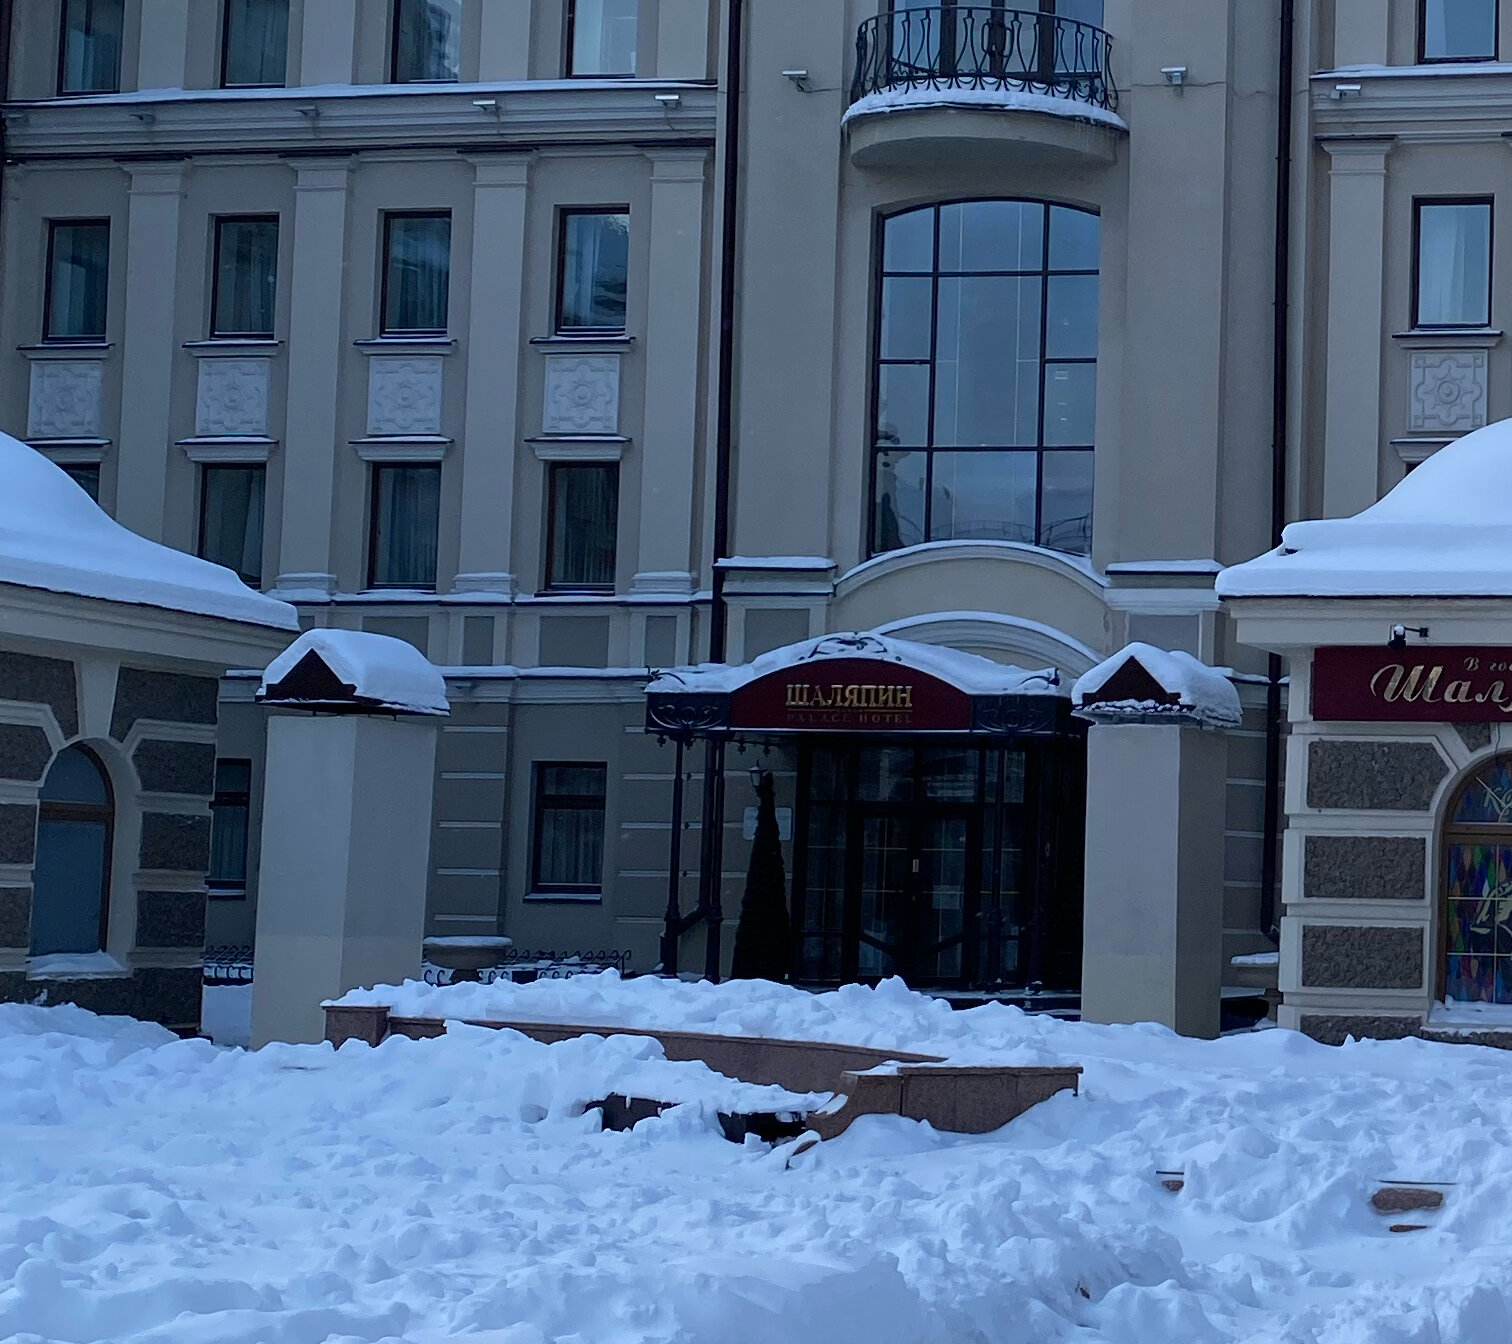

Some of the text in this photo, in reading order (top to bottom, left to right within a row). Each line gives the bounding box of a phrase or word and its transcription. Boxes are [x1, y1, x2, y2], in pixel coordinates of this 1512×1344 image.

[1463, 657, 1480, 671] В
[785, 684, 912, 707] ШАЛЯПИН
[787, 714, 912, 723] PALACE HOTEL
